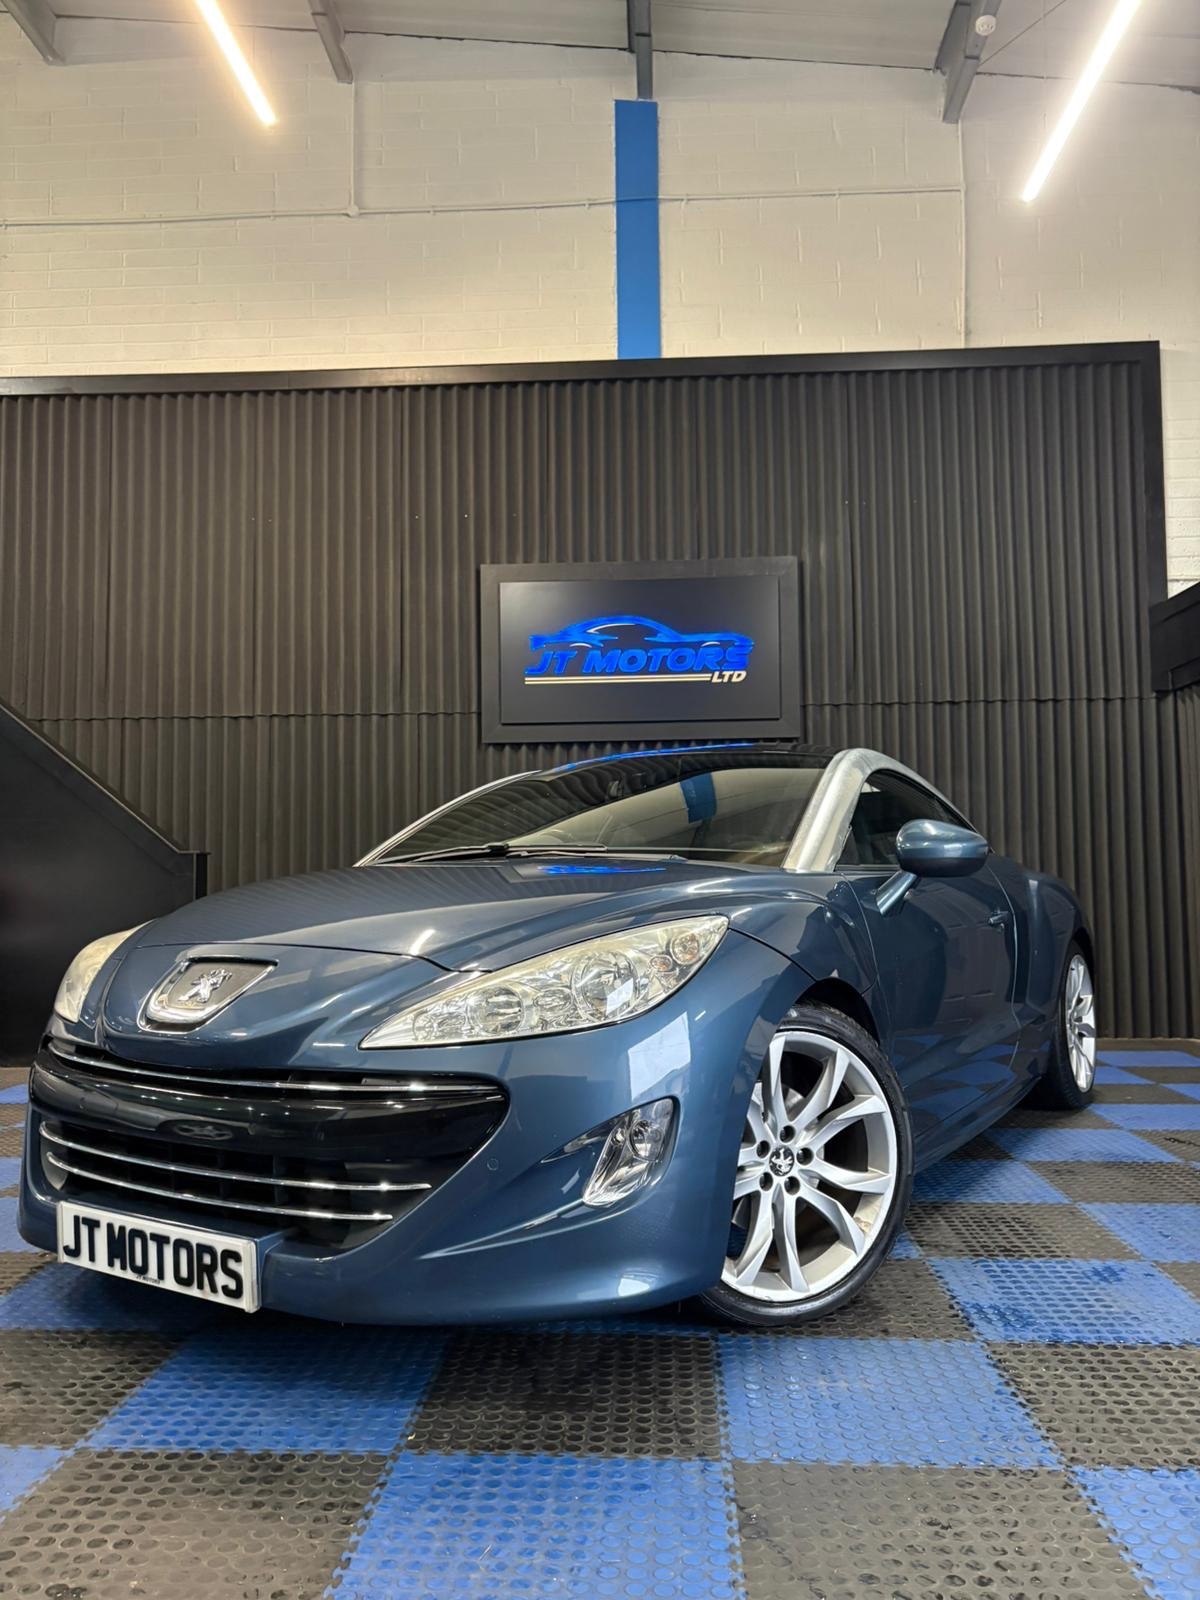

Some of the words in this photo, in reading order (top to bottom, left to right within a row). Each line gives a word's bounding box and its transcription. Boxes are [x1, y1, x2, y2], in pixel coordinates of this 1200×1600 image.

[525, 650, 577, 674] JT
[583, 647, 752, 673] MOTORS
[711, 670, 747, 683] LTD
[63, 1215, 101, 1262] JT
[106, 1223, 244, 1299] MOTORS
